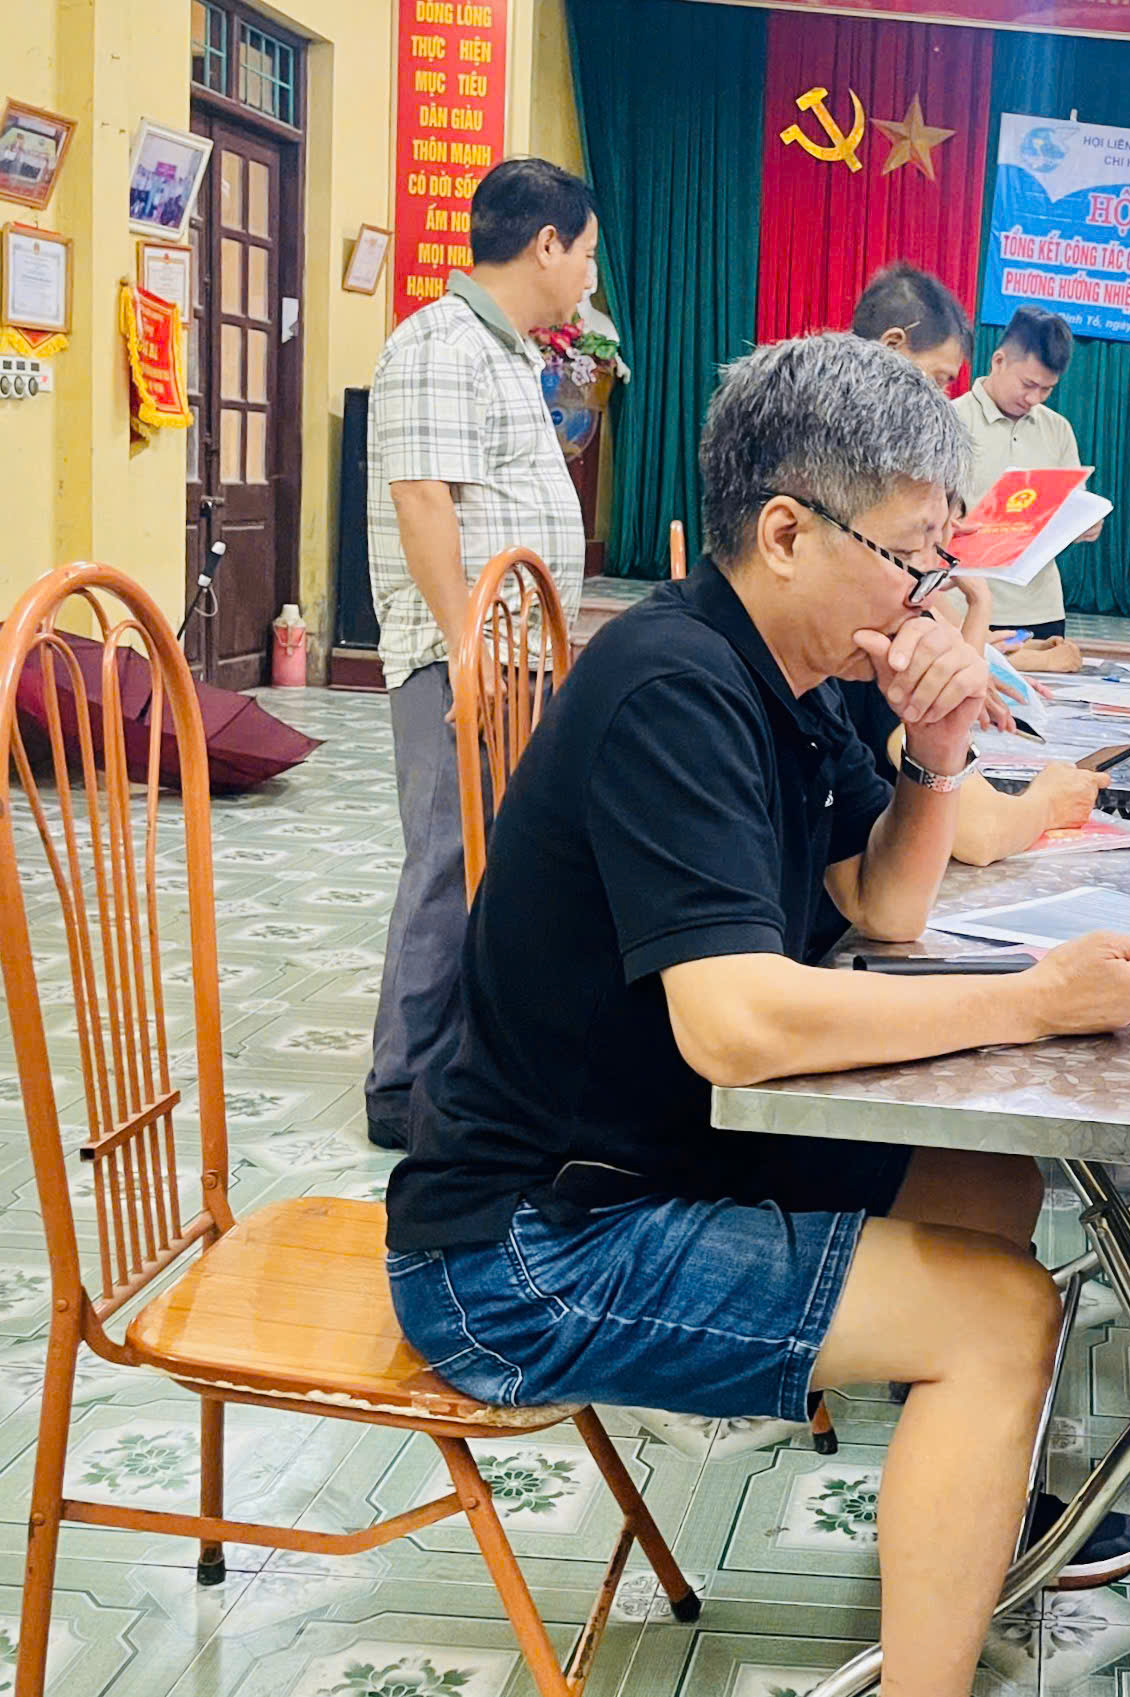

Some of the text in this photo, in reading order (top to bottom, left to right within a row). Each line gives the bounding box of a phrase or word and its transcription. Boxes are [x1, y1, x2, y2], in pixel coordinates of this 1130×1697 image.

[457, 0, 493, 28] LÒNG
[411, 34, 492, 67] THỰC HIỆN
[415, 70, 488, 97] MỤC TIÊU
[420, 102, 484, 131] DÂN GIÀU
[412, 136, 492, 168] THÔN MẠNH
[1104, 155, 1124, 167] CHI
[408, 170, 482, 199] CÓ ĐỜI SỐ
[418, 242, 445, 269] MỌI
[1002, 226, 1036, 259] TỔNG
[1038, 230, 1061, 262] KẾT
[1063, 236, 1098, 267] CÔNG
[1101, 241, 1124, 270] TÁC
[406, 275, 444, 301] HẠNH
[1005, 269, 1056, 297] PHƯƠNG
[1058, 272, 1100, 302] HƯỚNG
